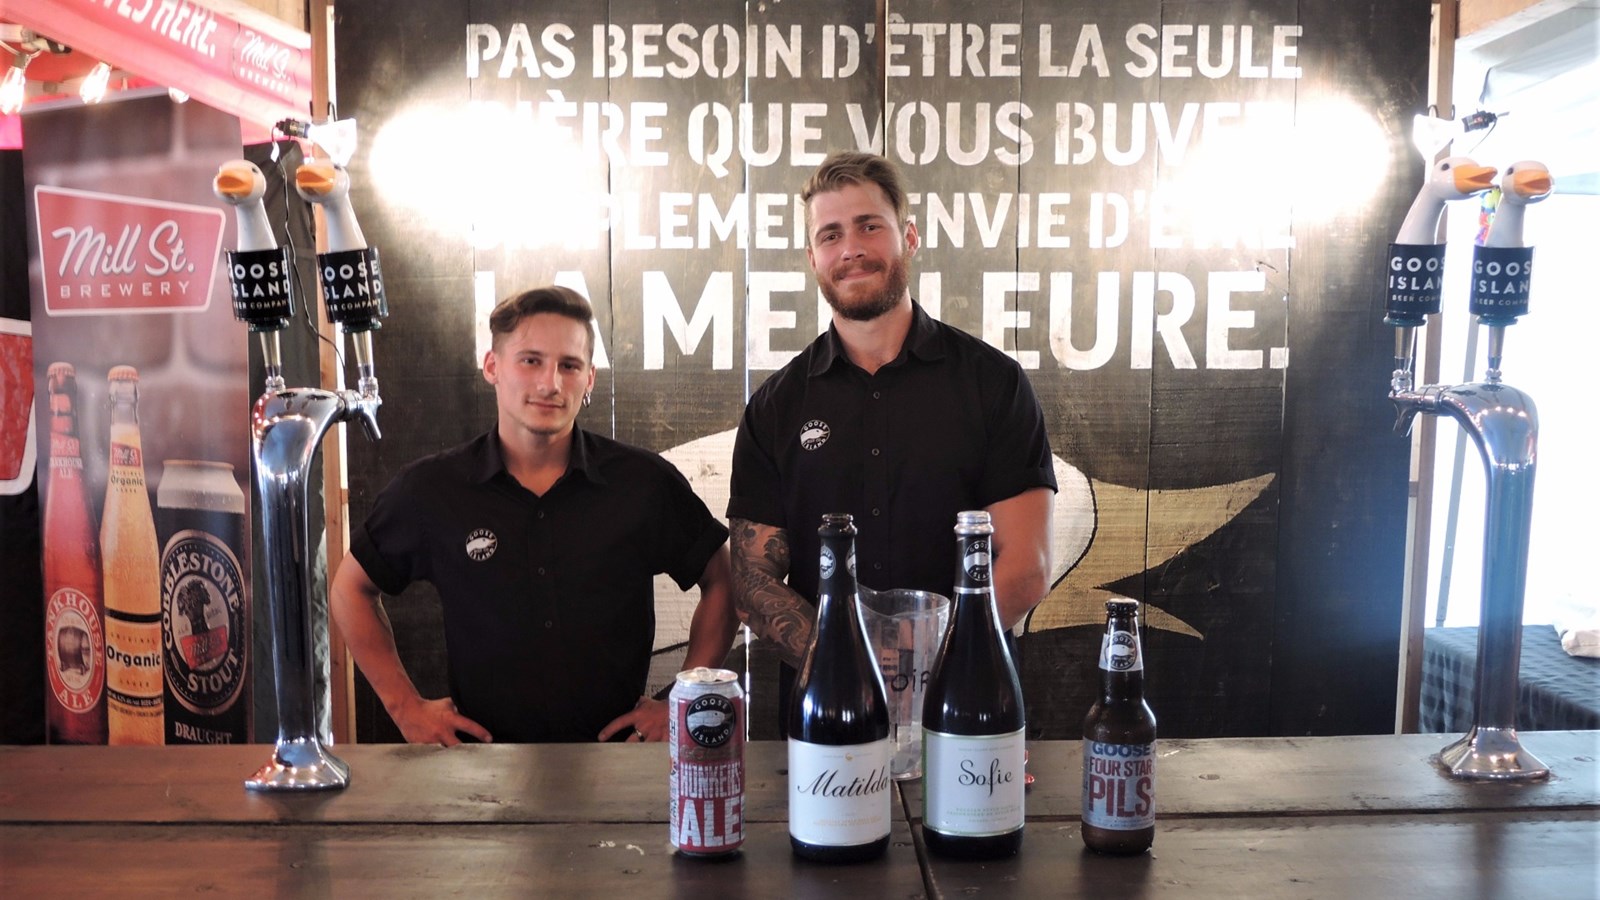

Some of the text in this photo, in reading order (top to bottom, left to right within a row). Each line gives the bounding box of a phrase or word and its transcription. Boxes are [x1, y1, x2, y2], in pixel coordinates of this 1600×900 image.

[466, 13, 1303, 79] PAS BESOIN D'ÊTRE LA SEULE
[472, 89, 669, 167] ÈRE
[687, 101, 828, 178] QUE
[846, 101, 1034, 166] VOUS
[52, 219, 196, 278] Mill St.
[229, 259, 288, 280] OOSE
[320, 260, 382, 283] OOSE
[1474, 260, 1531, 276] GOOS
[60, 280, 190, 299] BREWERY
[232, 278, 291, 299] SLAND
[324, 279, 383, 300] SLAND
[1472, 279, 1530, 294] ISLAN
[250, 299, 289, 309] COMPAN
[110, 474, 144, 487] Organic
[162, 551, 240, 650] COBBLESTONE
[106, 645, 161, 668] Organic
[186, 647, 238, 696] STOUT
[59, 687, 94, 710] ALE
[694, 698, 728, 711] GOOSE
[174, 721, 233, 745] DRAUGHT
[694, 728, 730, 745] ISLAND
[1092, 742, 1151, 758] GOOSE
[958, 758, 1014, 797] Sofie
[1089, 756, 1153, 778] FOUR STAR
[797, 765, 888, 798] Matilda
[1088, 773, 1153, 818] PILS
[679, 797, 741, 848] ALE
